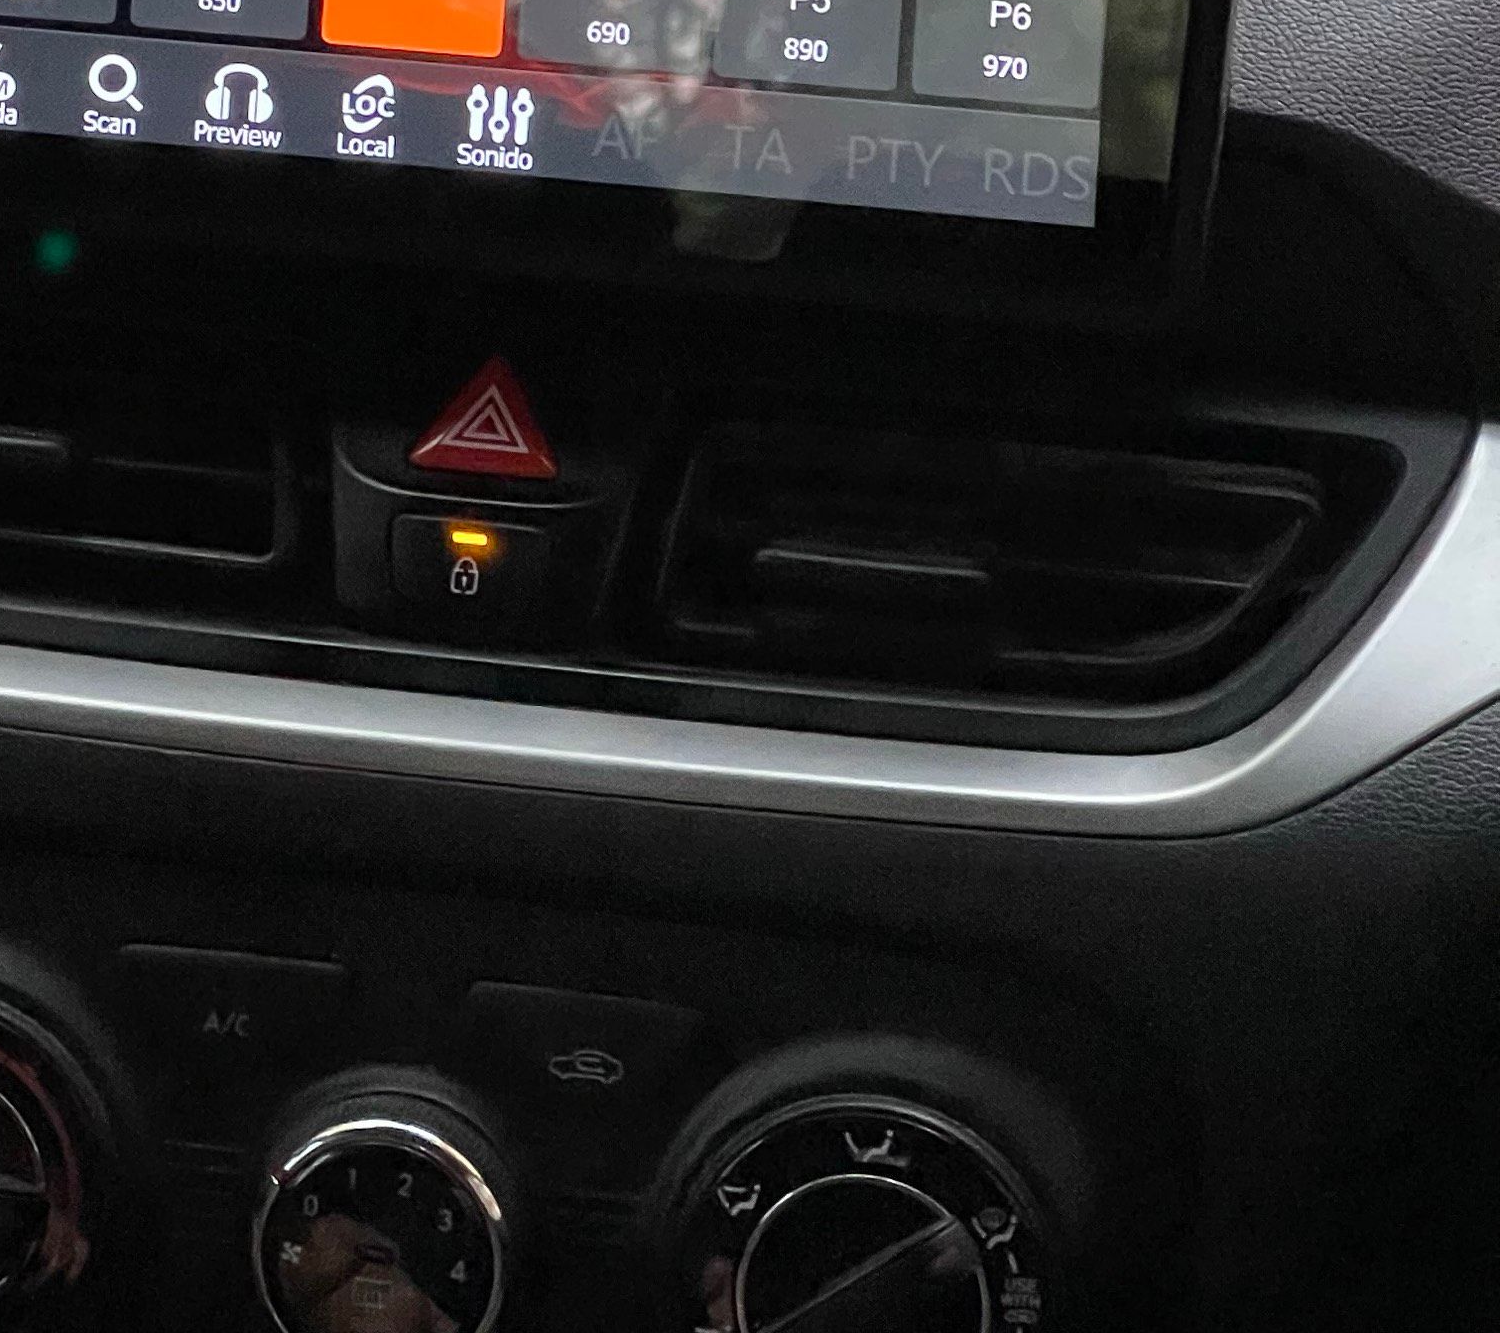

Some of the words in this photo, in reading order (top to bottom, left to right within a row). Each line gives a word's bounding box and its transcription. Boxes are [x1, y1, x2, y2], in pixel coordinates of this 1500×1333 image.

[989, 0, 1032, 31] P6
[586, 21, 631, 47] 690
[783, 37, 829, 64] 890
[982, 54, 1029, 81] 970
[341, 93, 396, 119] LOC
[82, 110, 137, 136] Scan
[194, 121, 283, 150] Preview
[336, 133, 396, 159] Local
[457, 143, 534, 171] Sonido
[726, 124, 792, 175] TA
[846, 135, 945, 187] PTY
[984, 147, 1093, 201] RDS
[202, 1009, 250, 1038] A/C
[347, 1167, 358, 1190] 1
[397, 1172, 414, 1198] 2
[436, 1209, 454, 1233] 3
[448, 1260, 467, 1283] 4
